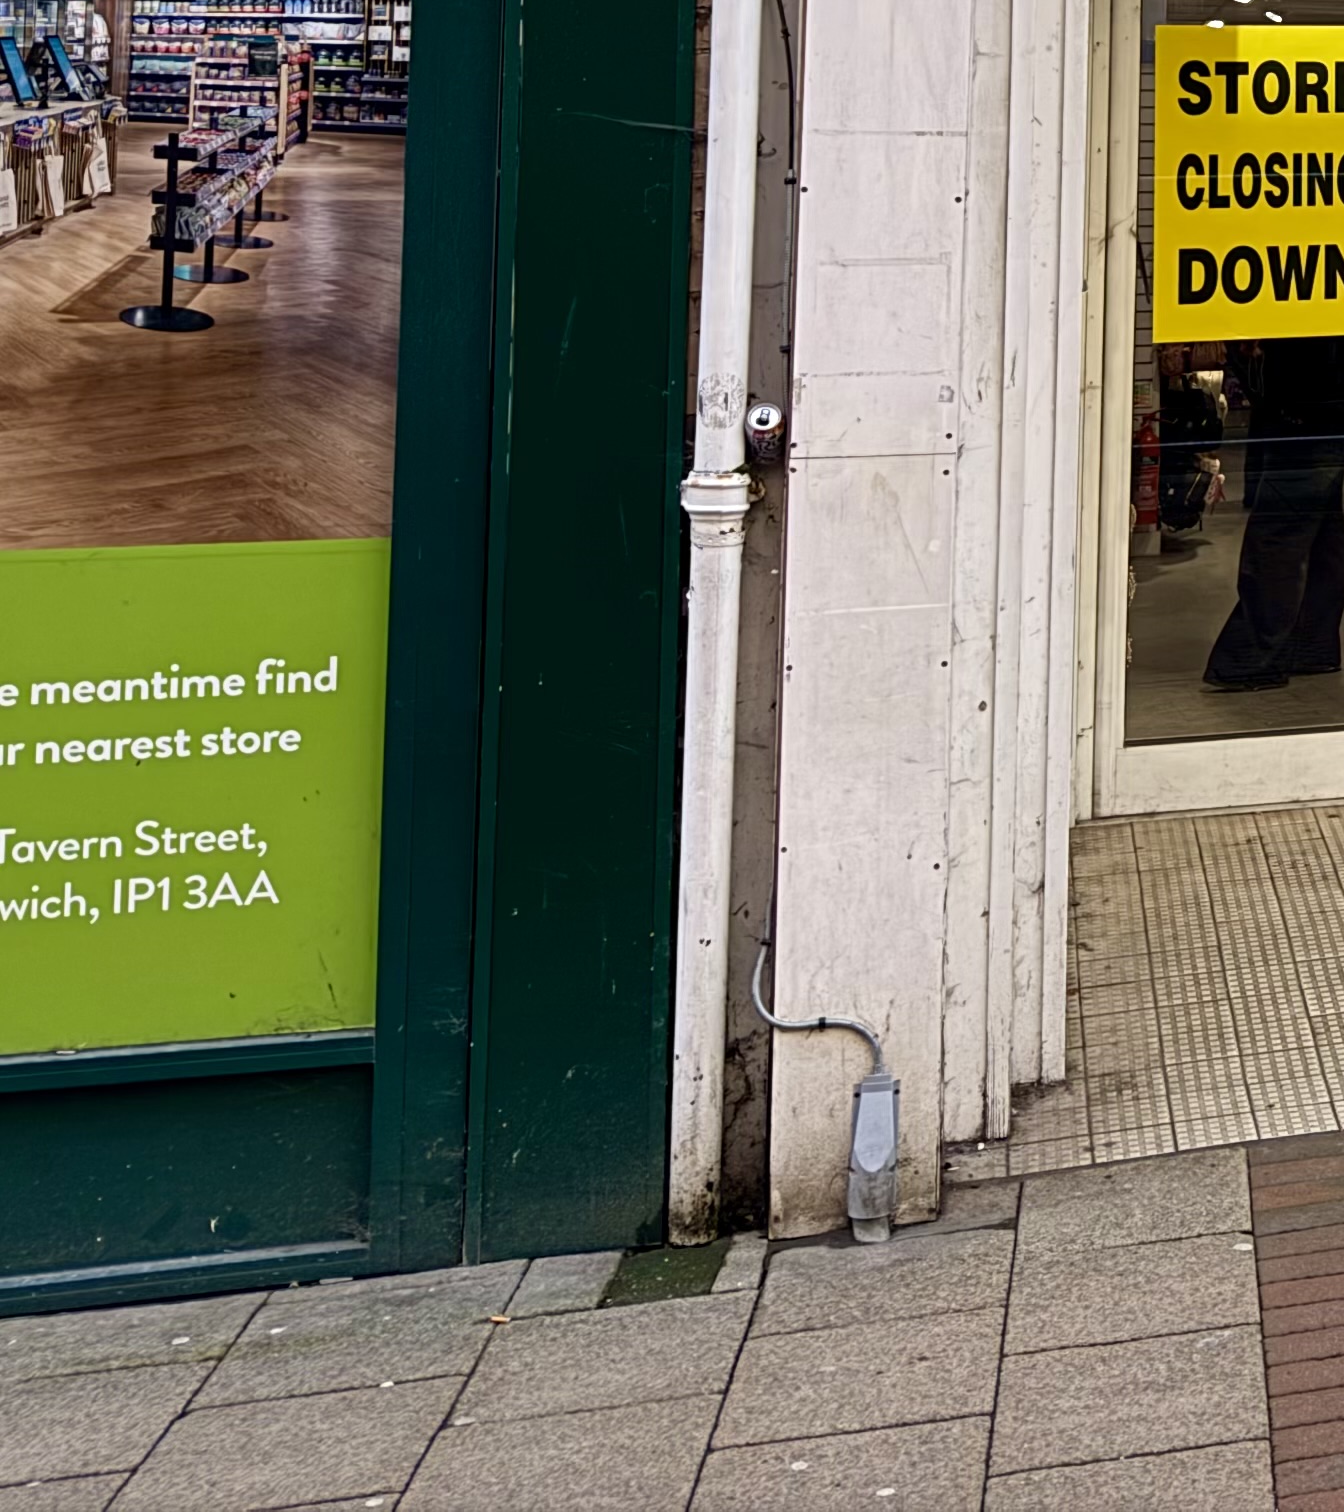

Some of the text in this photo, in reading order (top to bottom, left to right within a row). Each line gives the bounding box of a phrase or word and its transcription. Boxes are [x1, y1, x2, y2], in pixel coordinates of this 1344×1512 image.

[30, 663, 246, 705] meantime
[255, 656, 339, 695] find
[35, 728, 191, 764] nearest
[201, 726, 302, 756] store
[0, 819, 268, 865] Tavern Street,
[112, 876, 172, 914] IP1
[182, 869, 280, 910] 3AA
